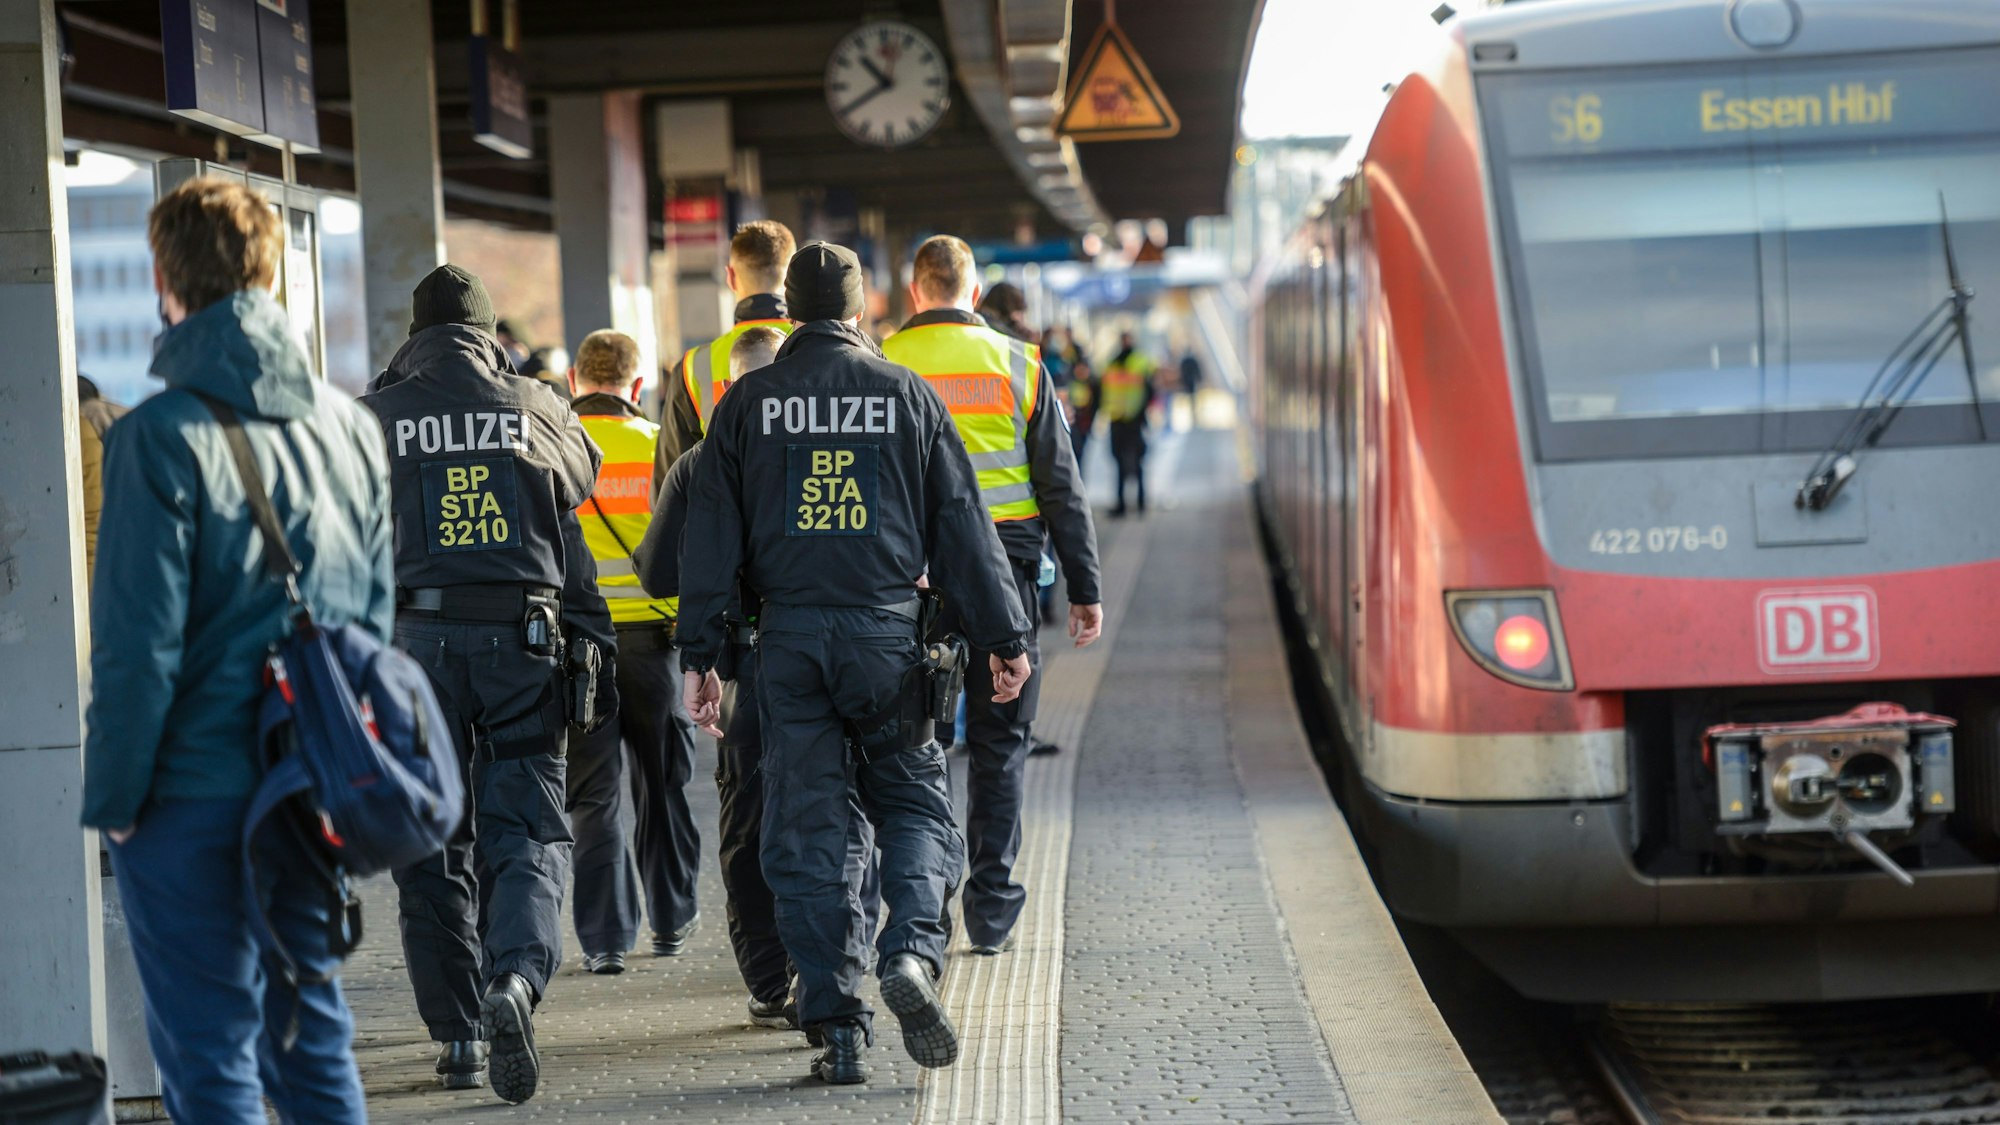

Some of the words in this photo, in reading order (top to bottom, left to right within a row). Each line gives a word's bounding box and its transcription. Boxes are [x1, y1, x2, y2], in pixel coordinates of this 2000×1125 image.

[1551, 94, 1602, 143] S6
[1702, 90, 1821, 132] Essen
[1829, 82, 1896, 125] Hbf
[762, 396, 896, 435] POLIZEI
[395, 412, 529, 457] POLIZEI
[812, 450, 855, 475] BP
[446, 465, 490, 492] BP
[801, 477, 863, 503] STA
[440, 491, 502, 520] STA
[796, 504, 867, 530] 3210
[438, 517, 509, 547] 3210
[1590, 529, 1642, 554] 422
[1647, 525, 1728, 552] 076-0
[1773, 603, 1864, 658] DB
